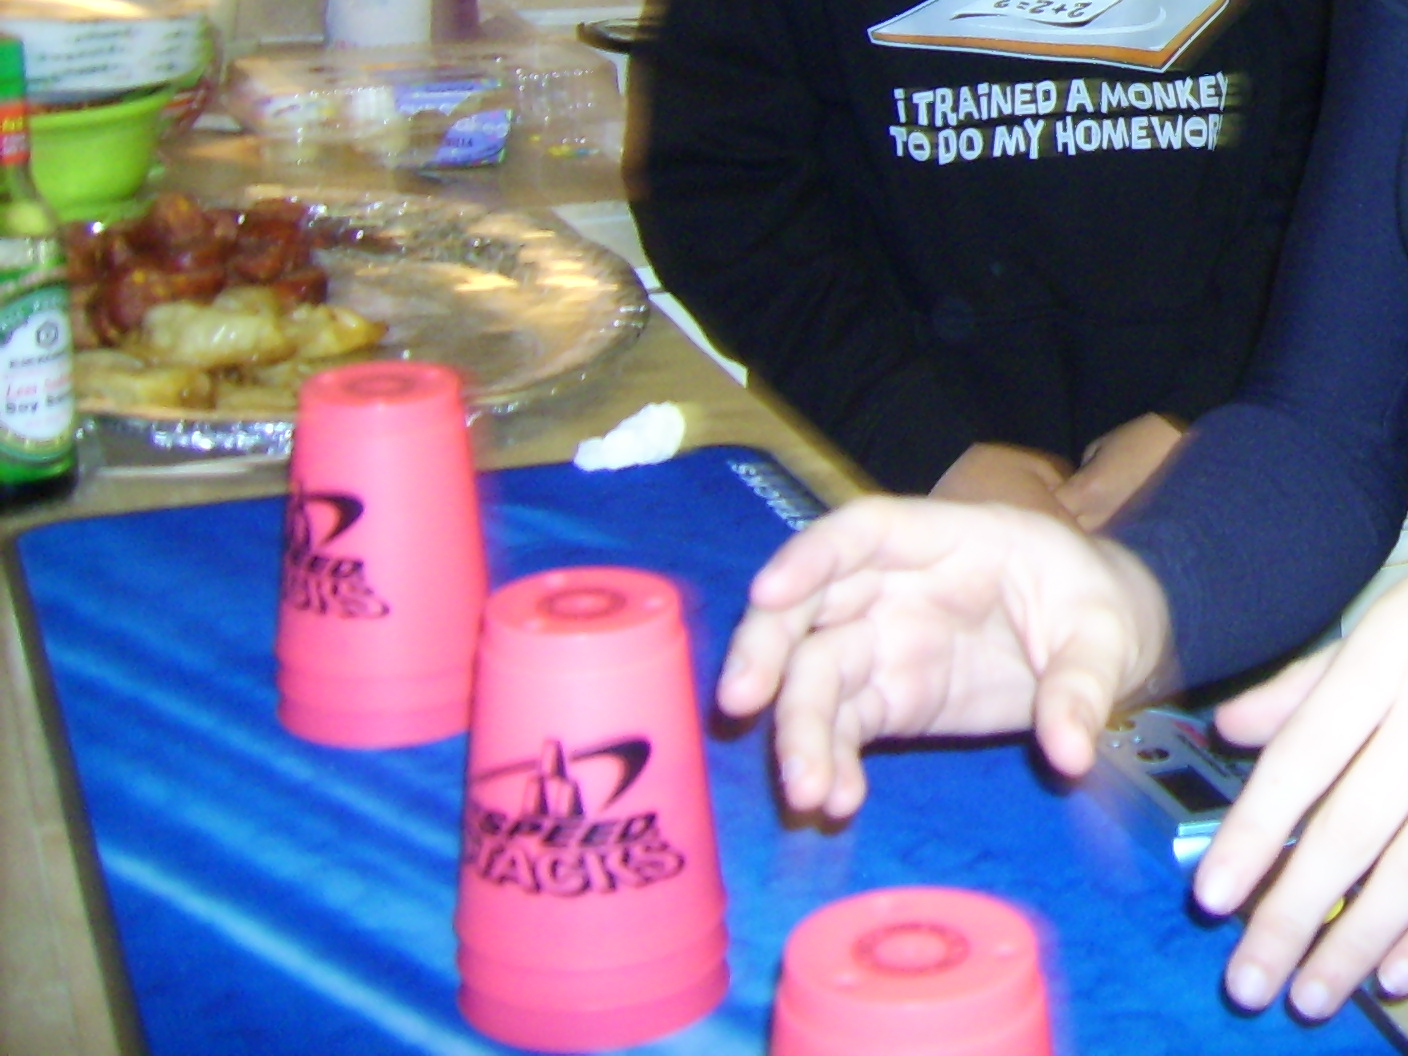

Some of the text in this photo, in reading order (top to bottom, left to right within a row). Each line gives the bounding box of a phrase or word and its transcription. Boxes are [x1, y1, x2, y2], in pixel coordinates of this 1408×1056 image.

[1065, 78, 1095, 113] A
[1100, 71, 1229, 114] MONKEY
[889, 114, 1225, 165] TO DO MY HOMEWOR
